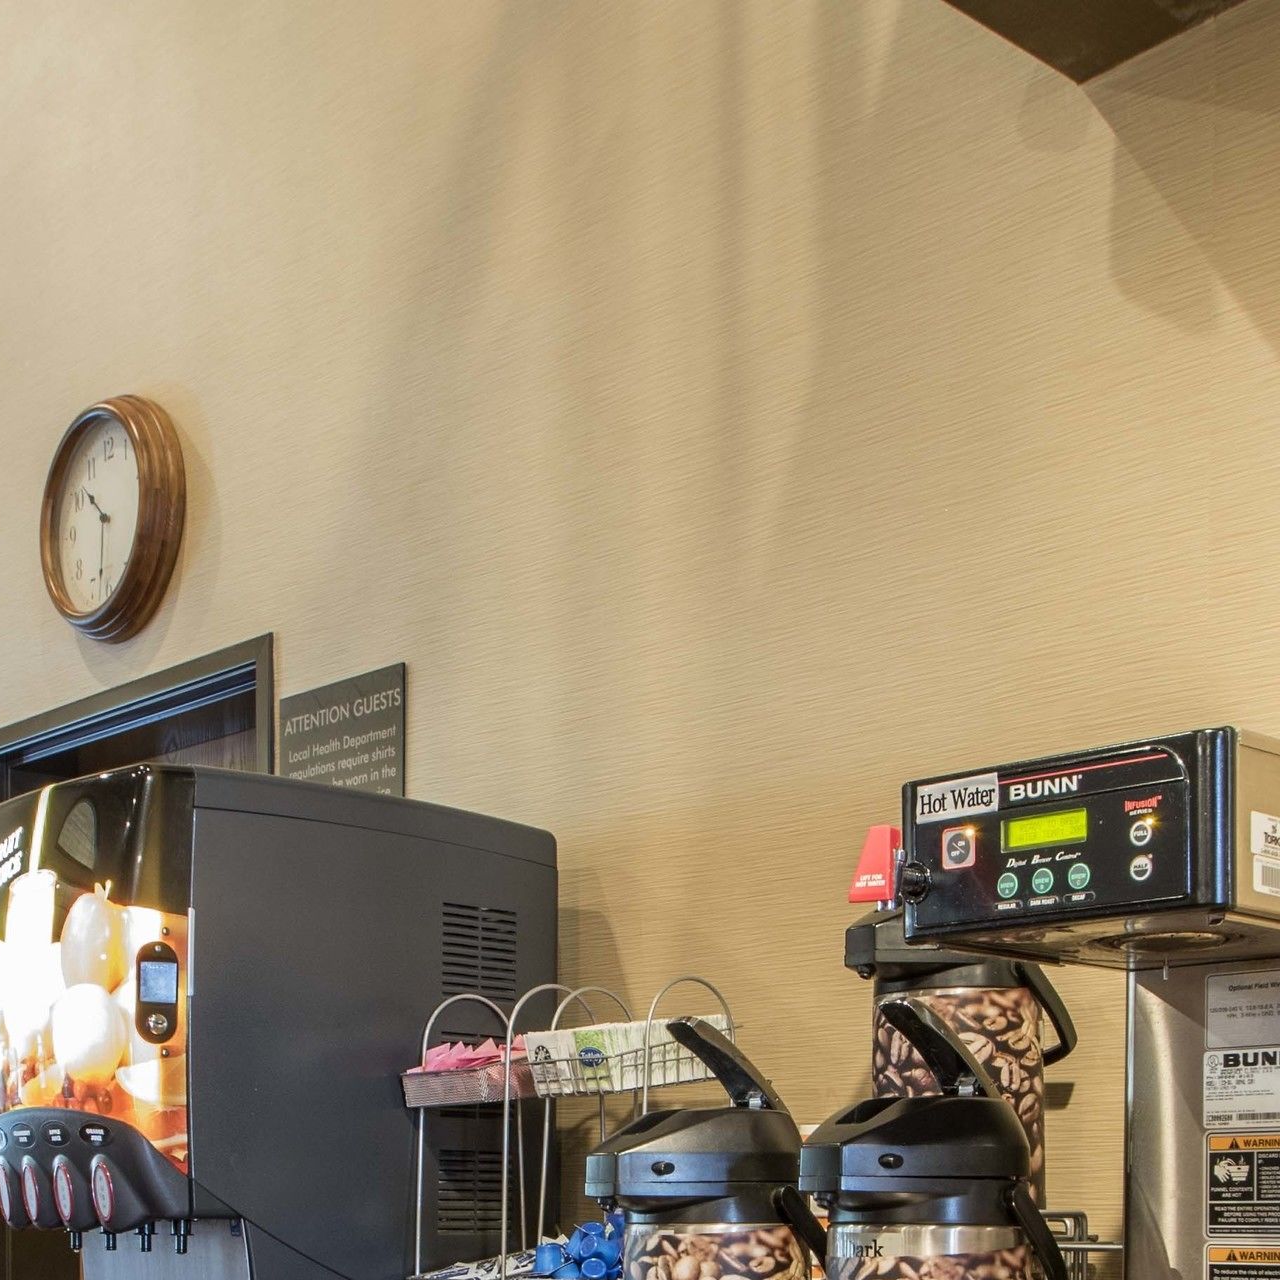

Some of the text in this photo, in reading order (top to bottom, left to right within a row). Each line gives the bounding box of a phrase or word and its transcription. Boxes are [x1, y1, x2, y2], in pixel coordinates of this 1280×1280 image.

[103, 436, 115, 463] 12
[123, 438, 128, 461] 1
[86, 457, 97, 481] 11
[73, 488, 85, 513] 10
[69, 526, 77, 545] 9
[75, 559, 84, 581] 8
[89, 578, 97, 601] 7
[104, 578, 113, 598] 6
[284, 687, 401, 737] ATTENTION GUESTS
[288, 723, 397, 764] Local Health Department
[288, 745, 397, 780] regulations require shirts
[345, 774, 368, 787] worn
[370, 768, 379, 781] in
[381, 764, 397, 778] the
[1009, 775, 1078, 801] BUNN
[920, 787, 995, 816] Hot Water
[1124, 798, 1157, 813] INFUSION
[1228, 983, 1253, 992] Optional
